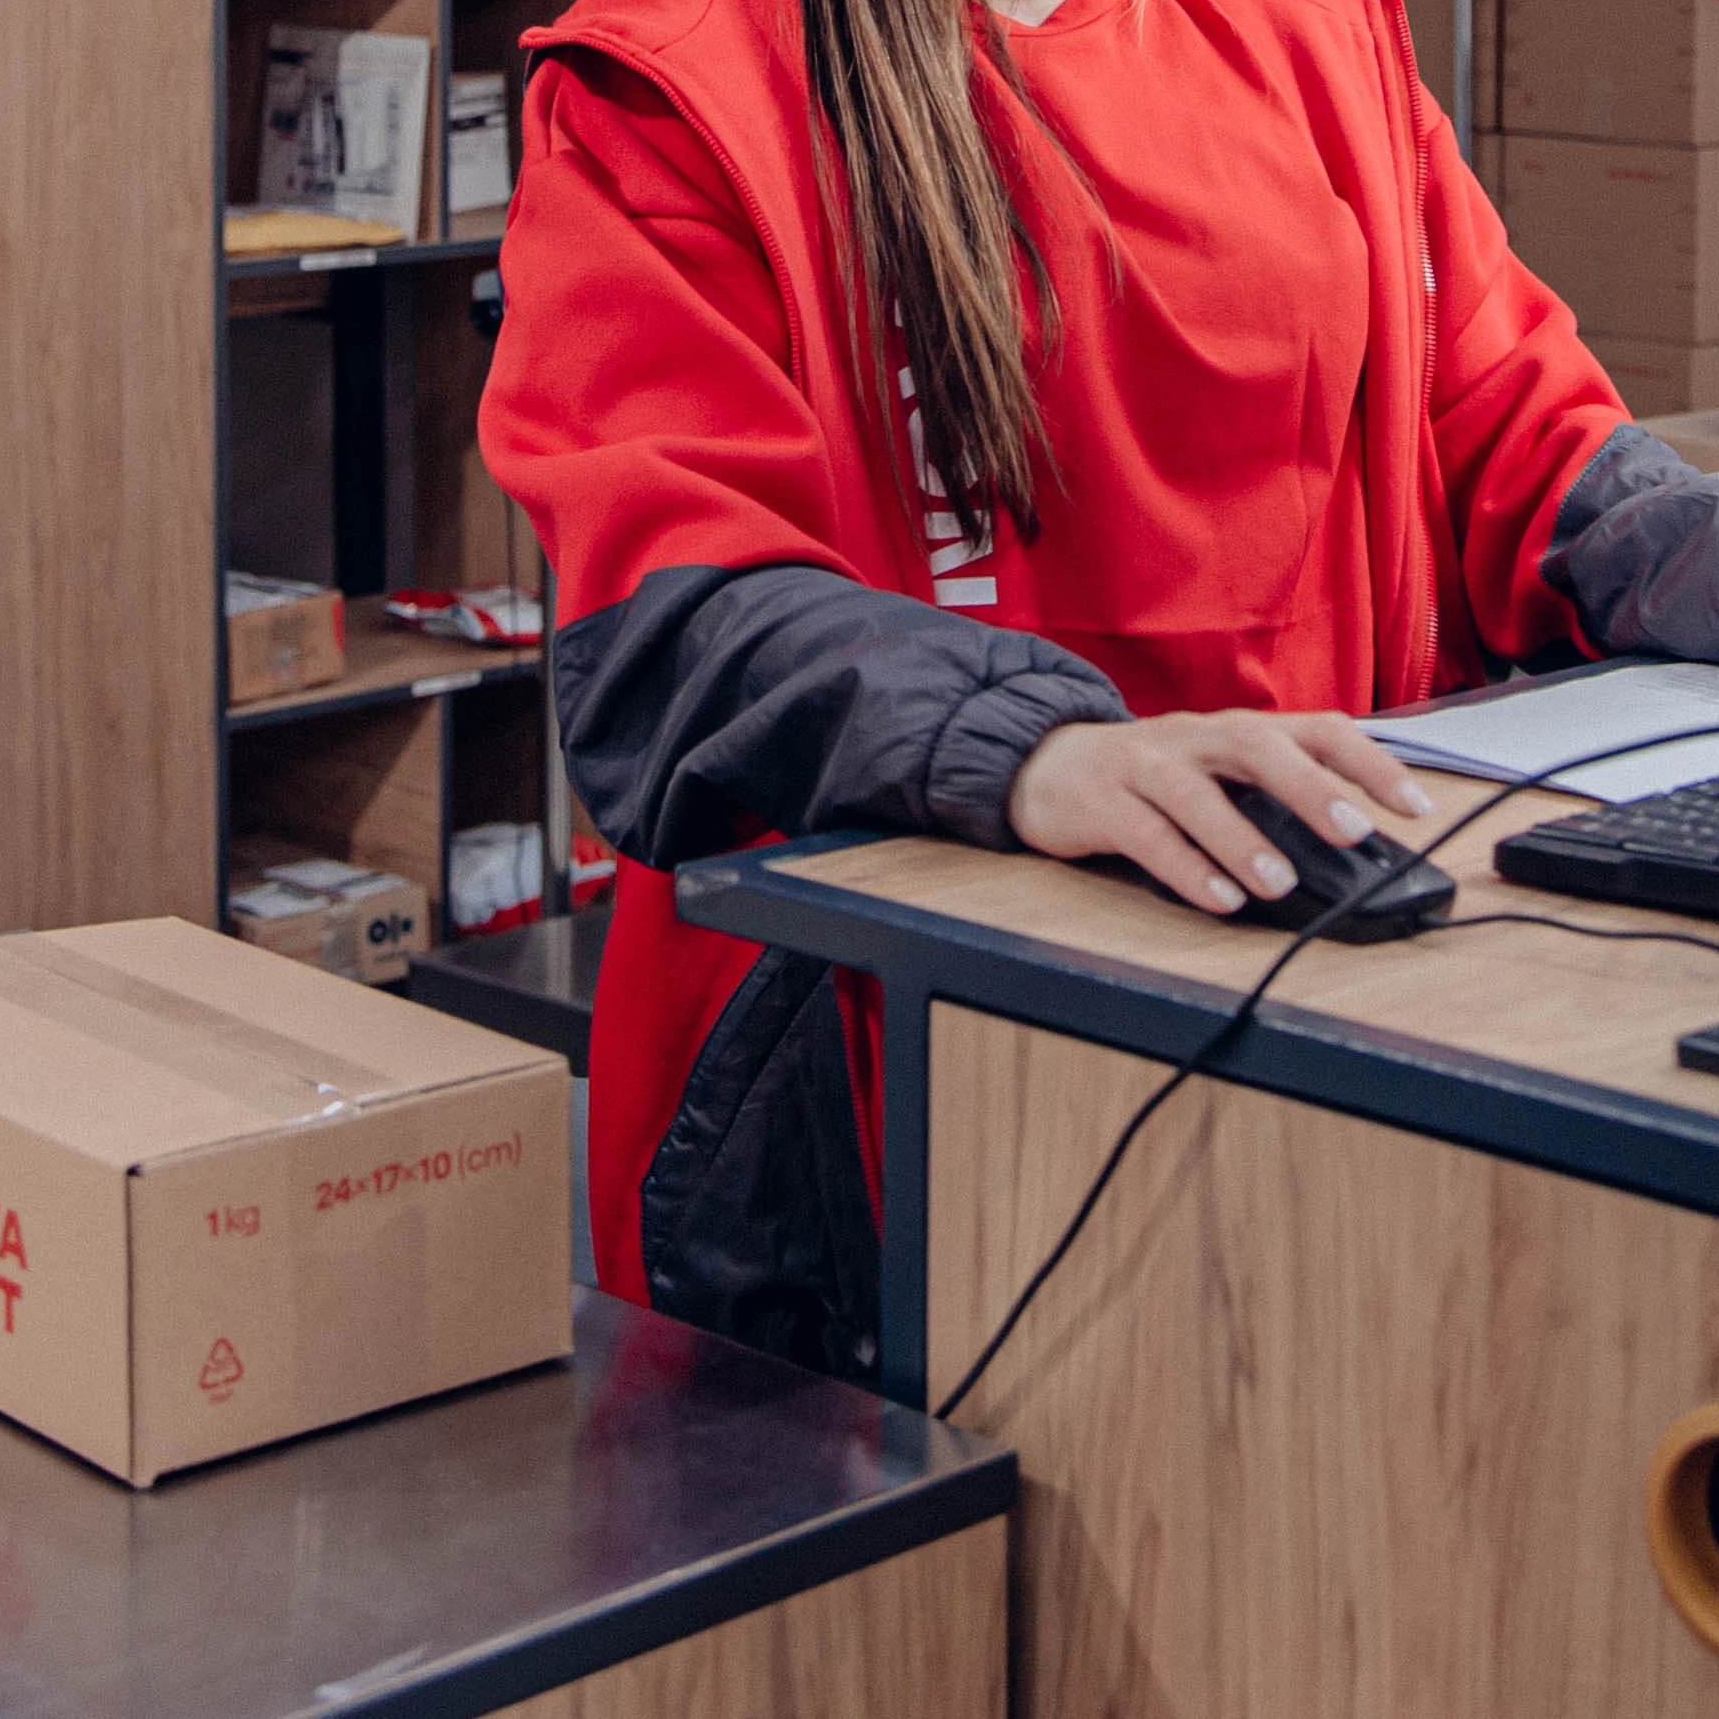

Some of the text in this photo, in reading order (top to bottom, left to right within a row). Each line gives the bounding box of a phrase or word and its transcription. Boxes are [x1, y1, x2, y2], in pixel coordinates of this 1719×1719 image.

[454, 1131, 523, 1179] (cm)
[205, 1204, 263, 1238] 1 kg
